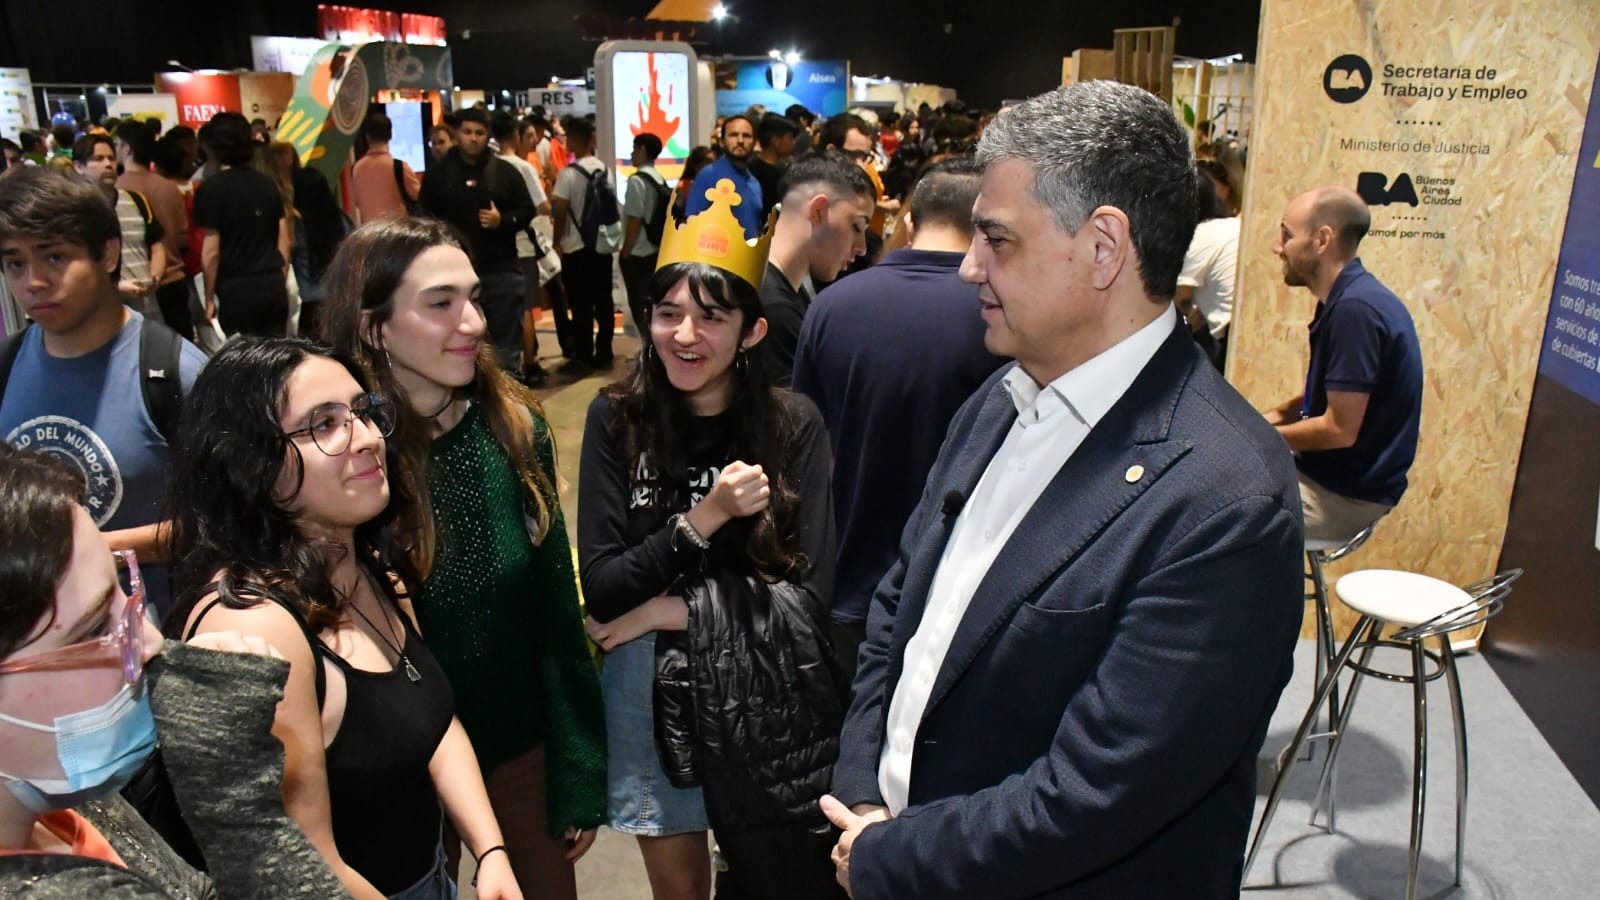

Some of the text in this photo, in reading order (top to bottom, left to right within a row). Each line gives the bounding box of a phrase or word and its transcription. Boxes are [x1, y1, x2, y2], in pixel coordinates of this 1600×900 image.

[1382, 64, 1497, 80] Secretaría de
[542, 91, 575, 105] RES
[1381, 83, 1528, 101] Trabajo y Empleo
[1340, 138, 1490, 155] Ministerio de Justicia
[1356, 171, 1419, 208] BA
[1420, 186, 1450, 196] Aires
[1423, 195, 1462, 206] Ciudad
[1367, 229, 1397, 238] amos
[1399, 230, 1420, 240] por
[1563, 269, 1600, 296] Somos tre
[1560, 295, 1600, 321] con 60 año
[1555, 316, 1599, 345] servicios de
[1551, 336, 1562, 353] de
[1561, 343, 1597, 370] cubiertas
[36, 427, 59, 441] DEL
[64, 431, 104, 473] MUNDO
